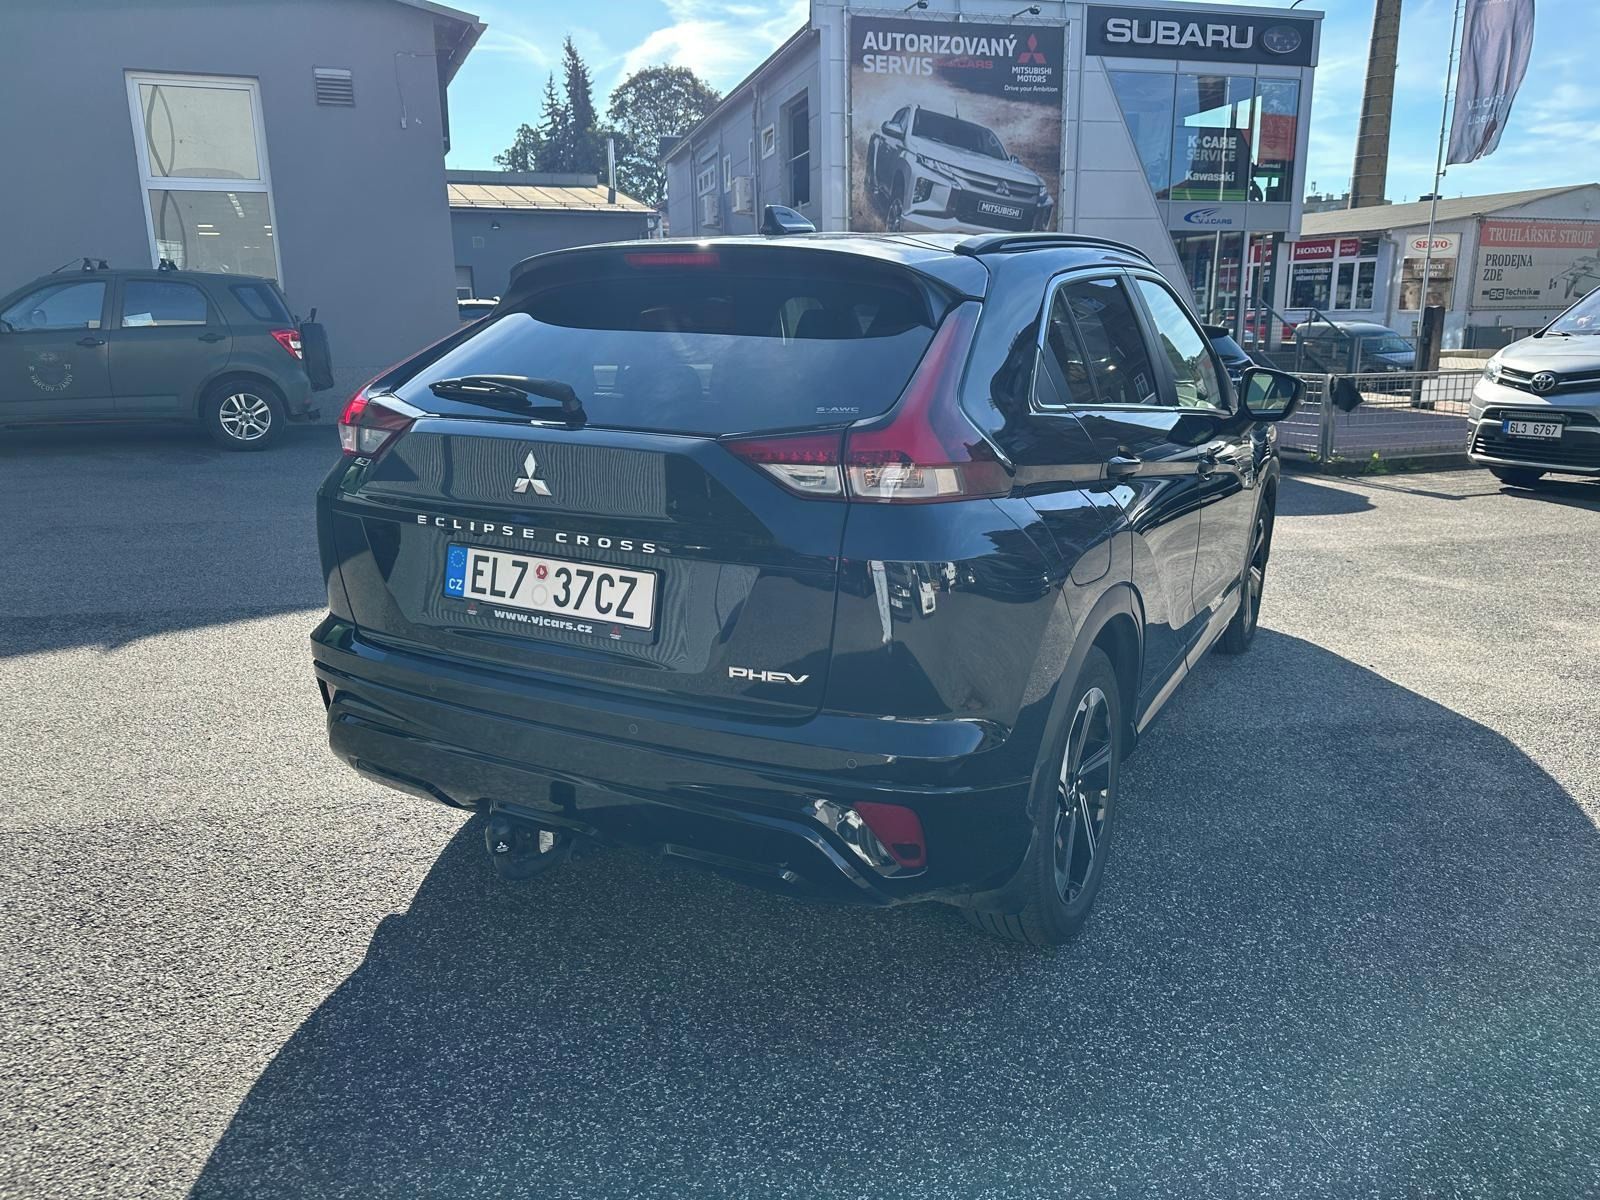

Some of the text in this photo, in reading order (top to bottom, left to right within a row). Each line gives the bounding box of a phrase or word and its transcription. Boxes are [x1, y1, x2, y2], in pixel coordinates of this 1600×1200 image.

[1106, 18, 1254, 49] SUBARU
[862, 31, 1018, 57] AUTORIZOVANÝ
[863, 54, 934, 76] SERVIS
[1011, 66, 1052, 75] MITSUBISHI
[1016, 75, 1047, 83] MOTORS
[1186, 148, 1236, 162] SERVICE
[1185, 169, 1235, 182] Kawasaki
[981, 202, 1020, 217] MITSUBISHI
[1488, 226, 1594, 246] TRUHLÁŘSKÉ STROJE
[1296, 246, 1332, 254] HONDA
[1485, 254, 1533, 269] PRODEJNA
[1483, 269, 1503, 281] ZDE
[1505, 288, 1533, 296] Technik
[1510, 422, 1558, 436] 6L3 6767
[417, 514, 656, 554] ECLIPSE CROSS
[448, 577, 463, 591] CZ
[470, 554, 637, 619] EL7 37CZ
[493, 609, 593, 634] www.vjcars.cz
[728, 666, 809, 684] PHEV
